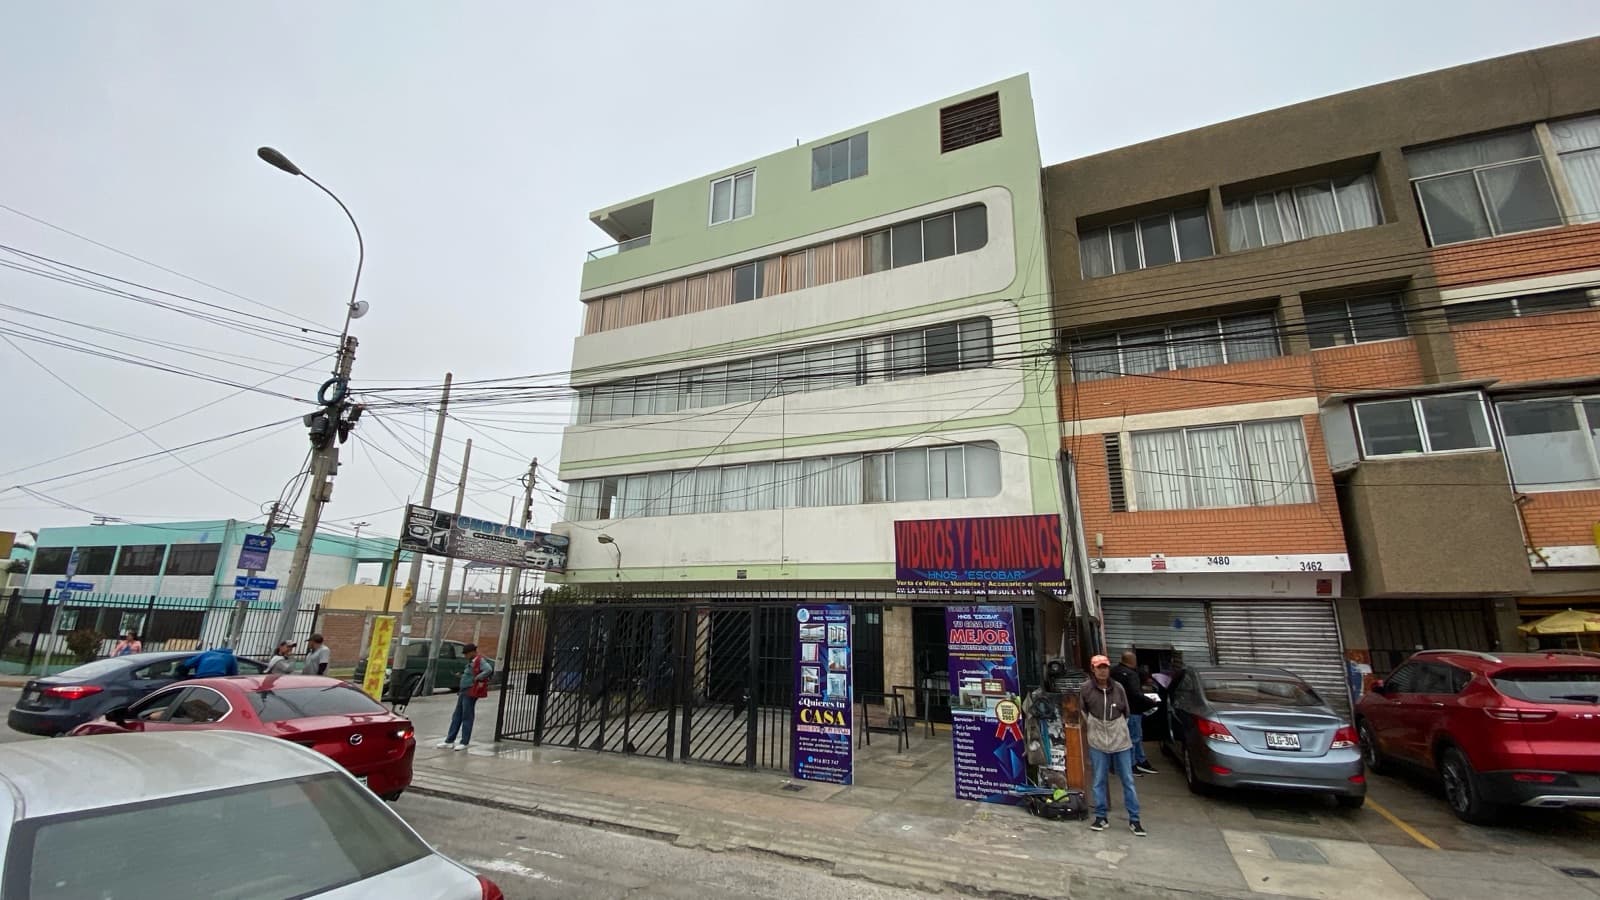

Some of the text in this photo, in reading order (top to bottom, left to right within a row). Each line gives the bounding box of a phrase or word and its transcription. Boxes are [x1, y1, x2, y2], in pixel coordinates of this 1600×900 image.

[897, 516, 1061, 570] VIDRIOS Y ALUMINIOS
[1207, 556, 1230, 566] 3480
[1299, 561, 1323, 571] 3462
[949, 629, 1010, 644] MEJOR
[798, 697, 835, 708] ¿Quieres
[800, 708, 846, 726] CASA
